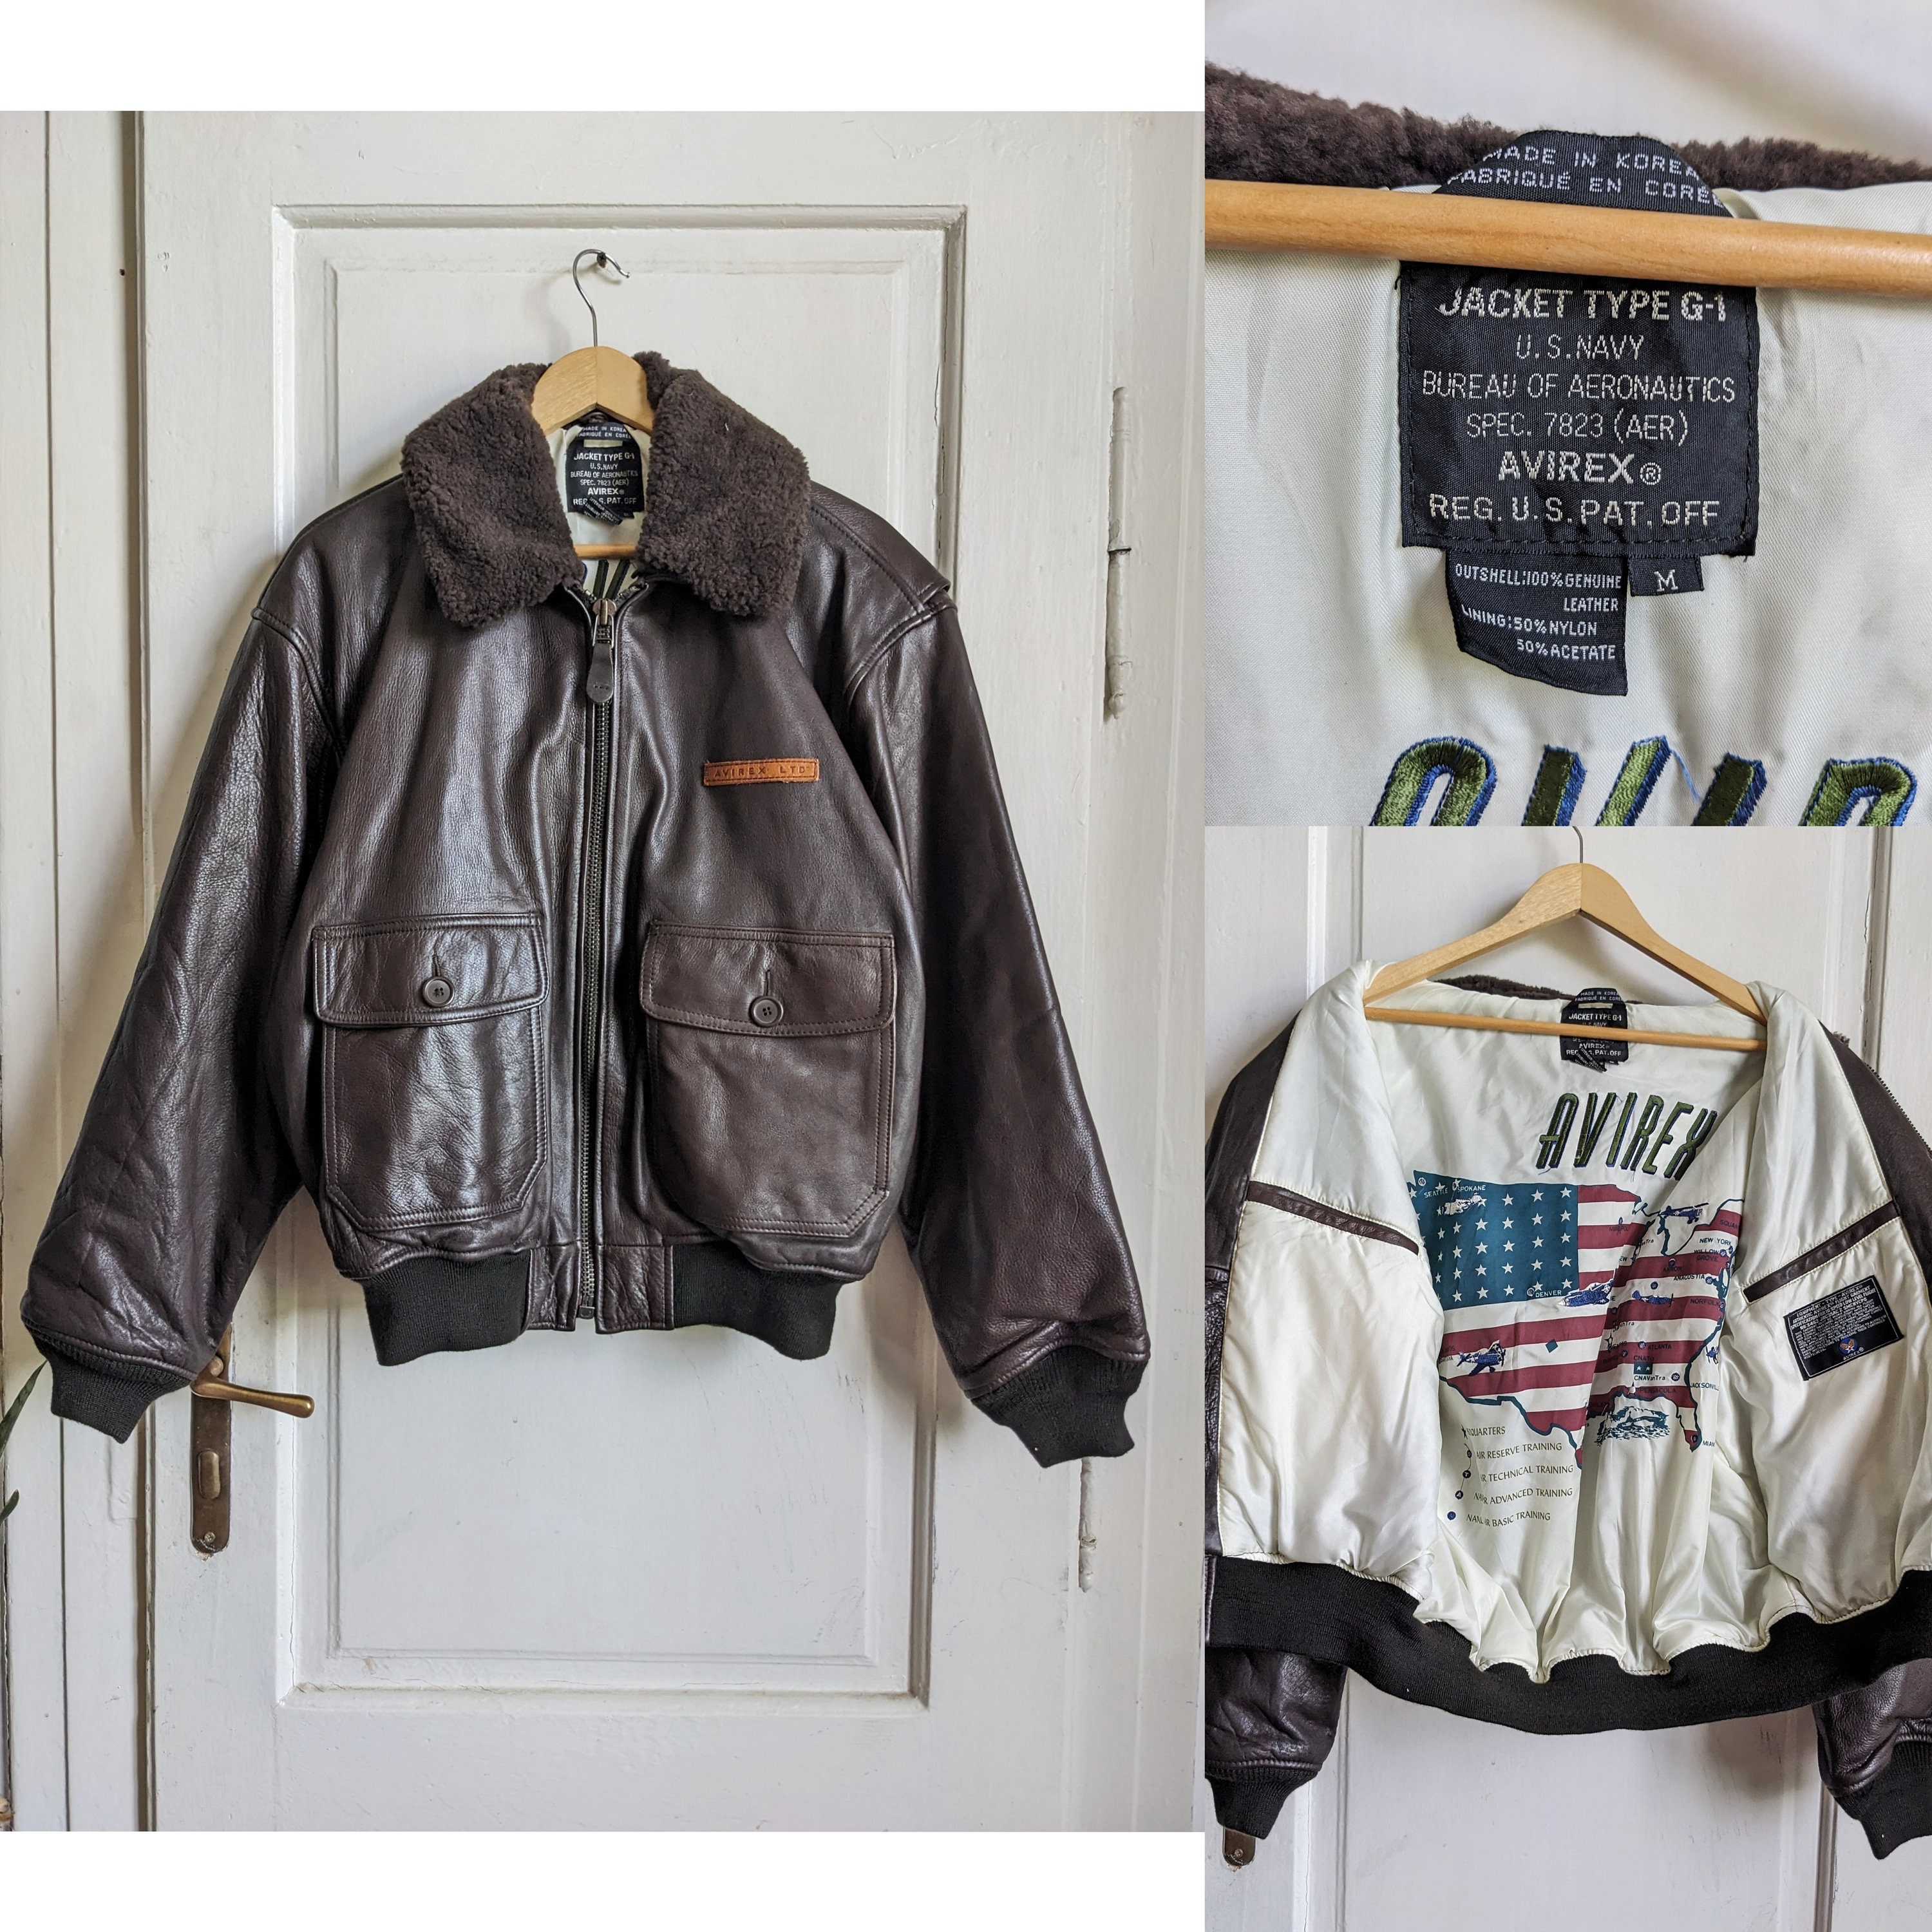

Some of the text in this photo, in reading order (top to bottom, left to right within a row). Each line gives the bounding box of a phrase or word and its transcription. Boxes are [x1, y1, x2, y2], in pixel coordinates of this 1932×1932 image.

[1574, 151, 1597, 169] IN
[1589, 177, 1622, 193] EN
[1439, 287, 1727, 323] JACKET TYPE G-1
[1423, 370, 1736, 403] BUREAU OF AERONAUTICS
[1466, 407, 1689, 448] SPEC. 7823 (AER)
[574, 452, 602, 460] JACKET
[603, 453, 623, 462] TYPE
[612, 478, 629, 487] (AER)
[1653, 569, 1680, 592] M
[1563, 597, 1619, 612] LEATHER
[714, 766, 766, 779] AVIREX
[1536, 1092, 1718, 1180] AVIREX
[1424, 1187, 1448, 1198] SEATTLE
[1487, 1445, 1520, 1459] RESERVE
[1522, 1443, 1562, 1452] TRAINING
[1488, 1466, 1533, 1482] TECHNICAL
[1535, 1464, 1573, 1474] TRAINING
[1490, 1488, 1533, 1504] ADVANCED
[1535, 1488, 1573, 1497] TRAINING
[1492, 1515, 1514, 1527] BASIC
[1516, 1511, 1551, 1521] TRAINING
